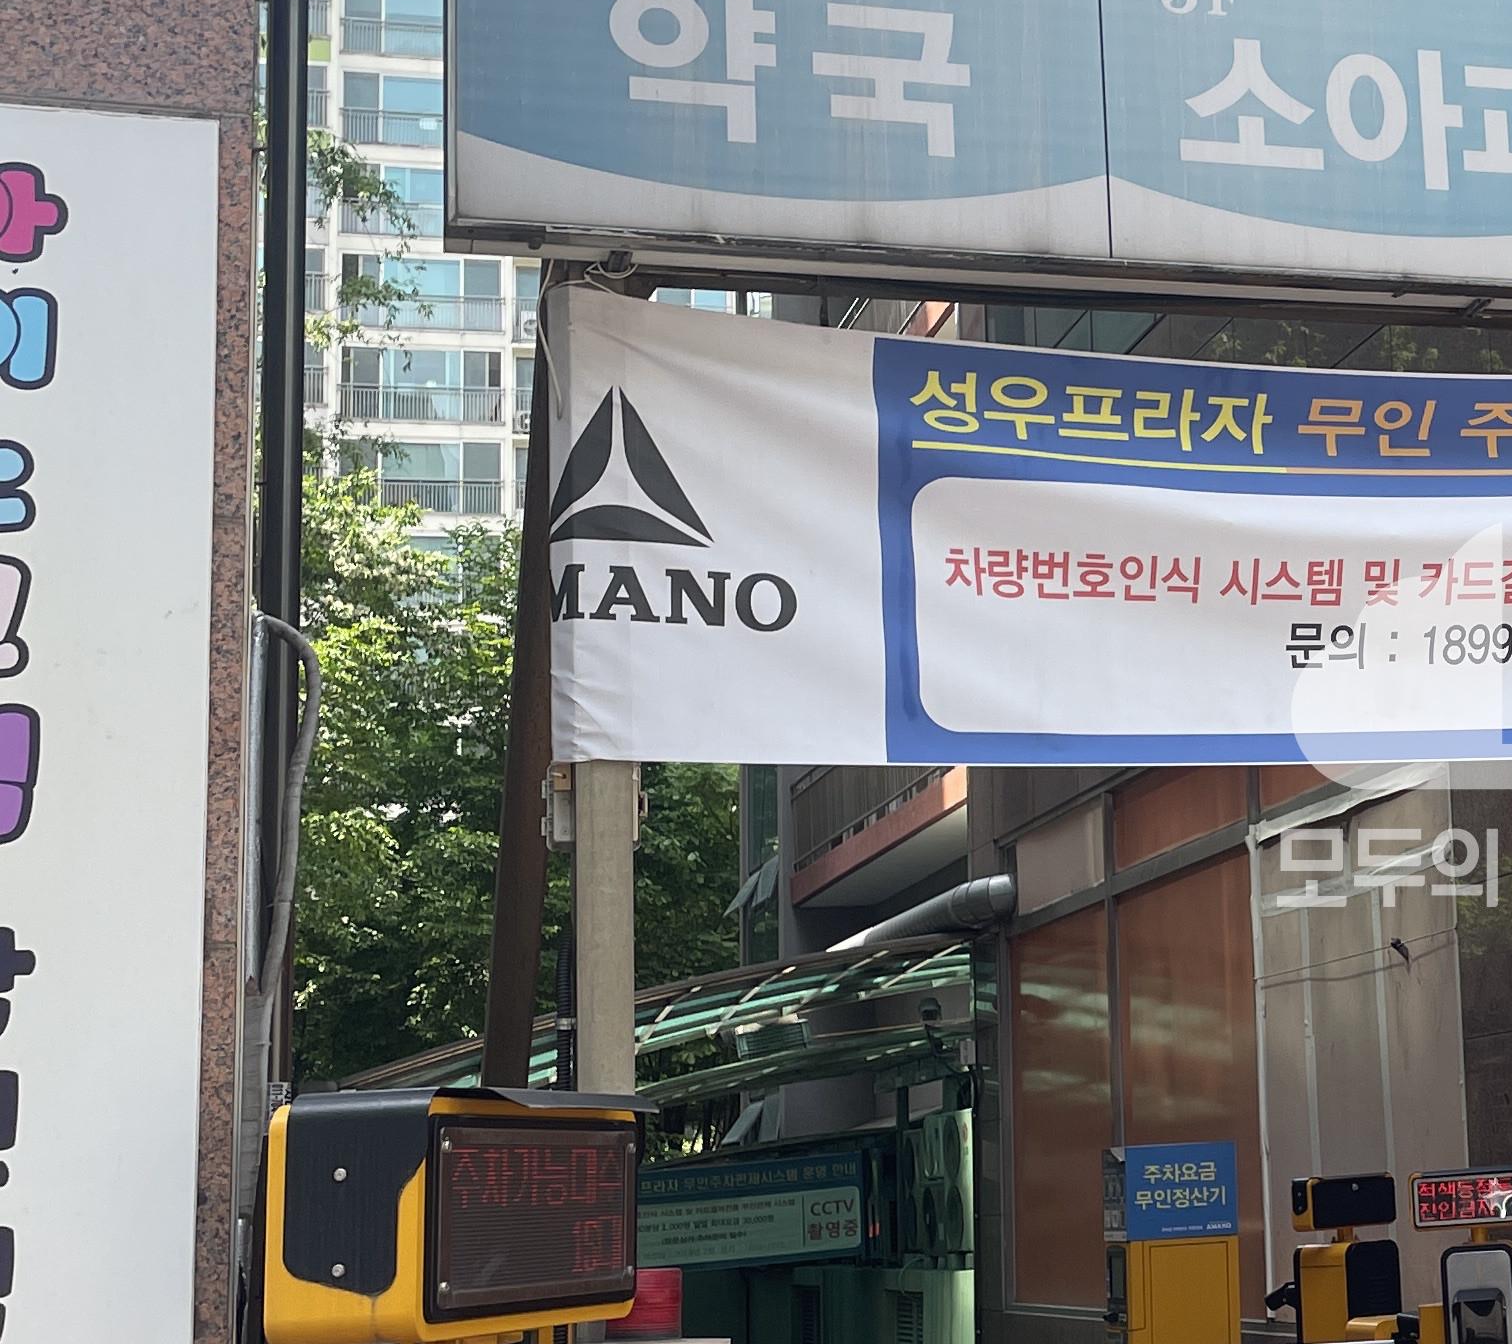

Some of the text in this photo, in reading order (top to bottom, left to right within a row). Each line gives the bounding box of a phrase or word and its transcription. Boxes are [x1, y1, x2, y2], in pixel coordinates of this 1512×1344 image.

[910, 370, 1273, 455] 성우프라자
[1298, 397, 1437, 458] 무인
[944, 544, 1202, 605] 차량번호인식
[1219, 557, 1343, 607] 시스템
[1363, 559, 1401, 607] 및
[1285, 620, 1366, 670] 문의
[1143, 1161, 1217, 1184] 주차요금
[810, 1199, 855, 1217] CCTV
[1134, 1185, 1226, 1211] 무인정산기
